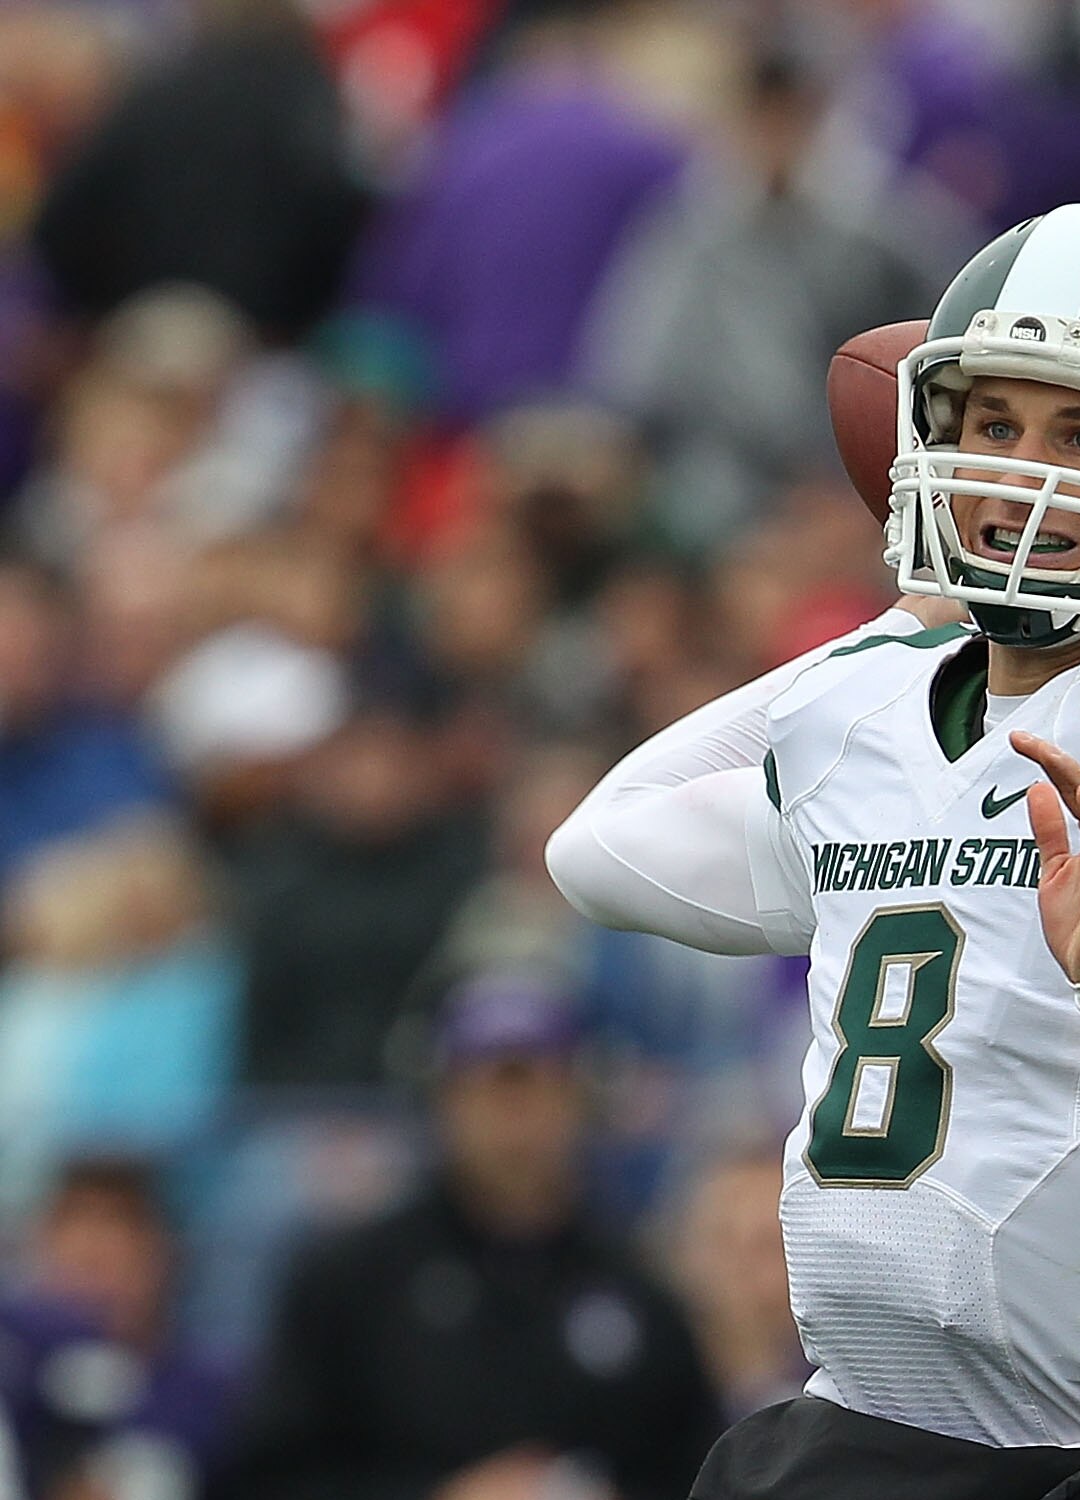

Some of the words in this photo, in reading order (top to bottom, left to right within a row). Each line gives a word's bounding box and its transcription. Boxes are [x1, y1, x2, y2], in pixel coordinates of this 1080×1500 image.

[1011, 326, 1041, 341] MSU
[811, 838, 953, 896] MICHIGAN
[802, 901, 967, 1190] 8
